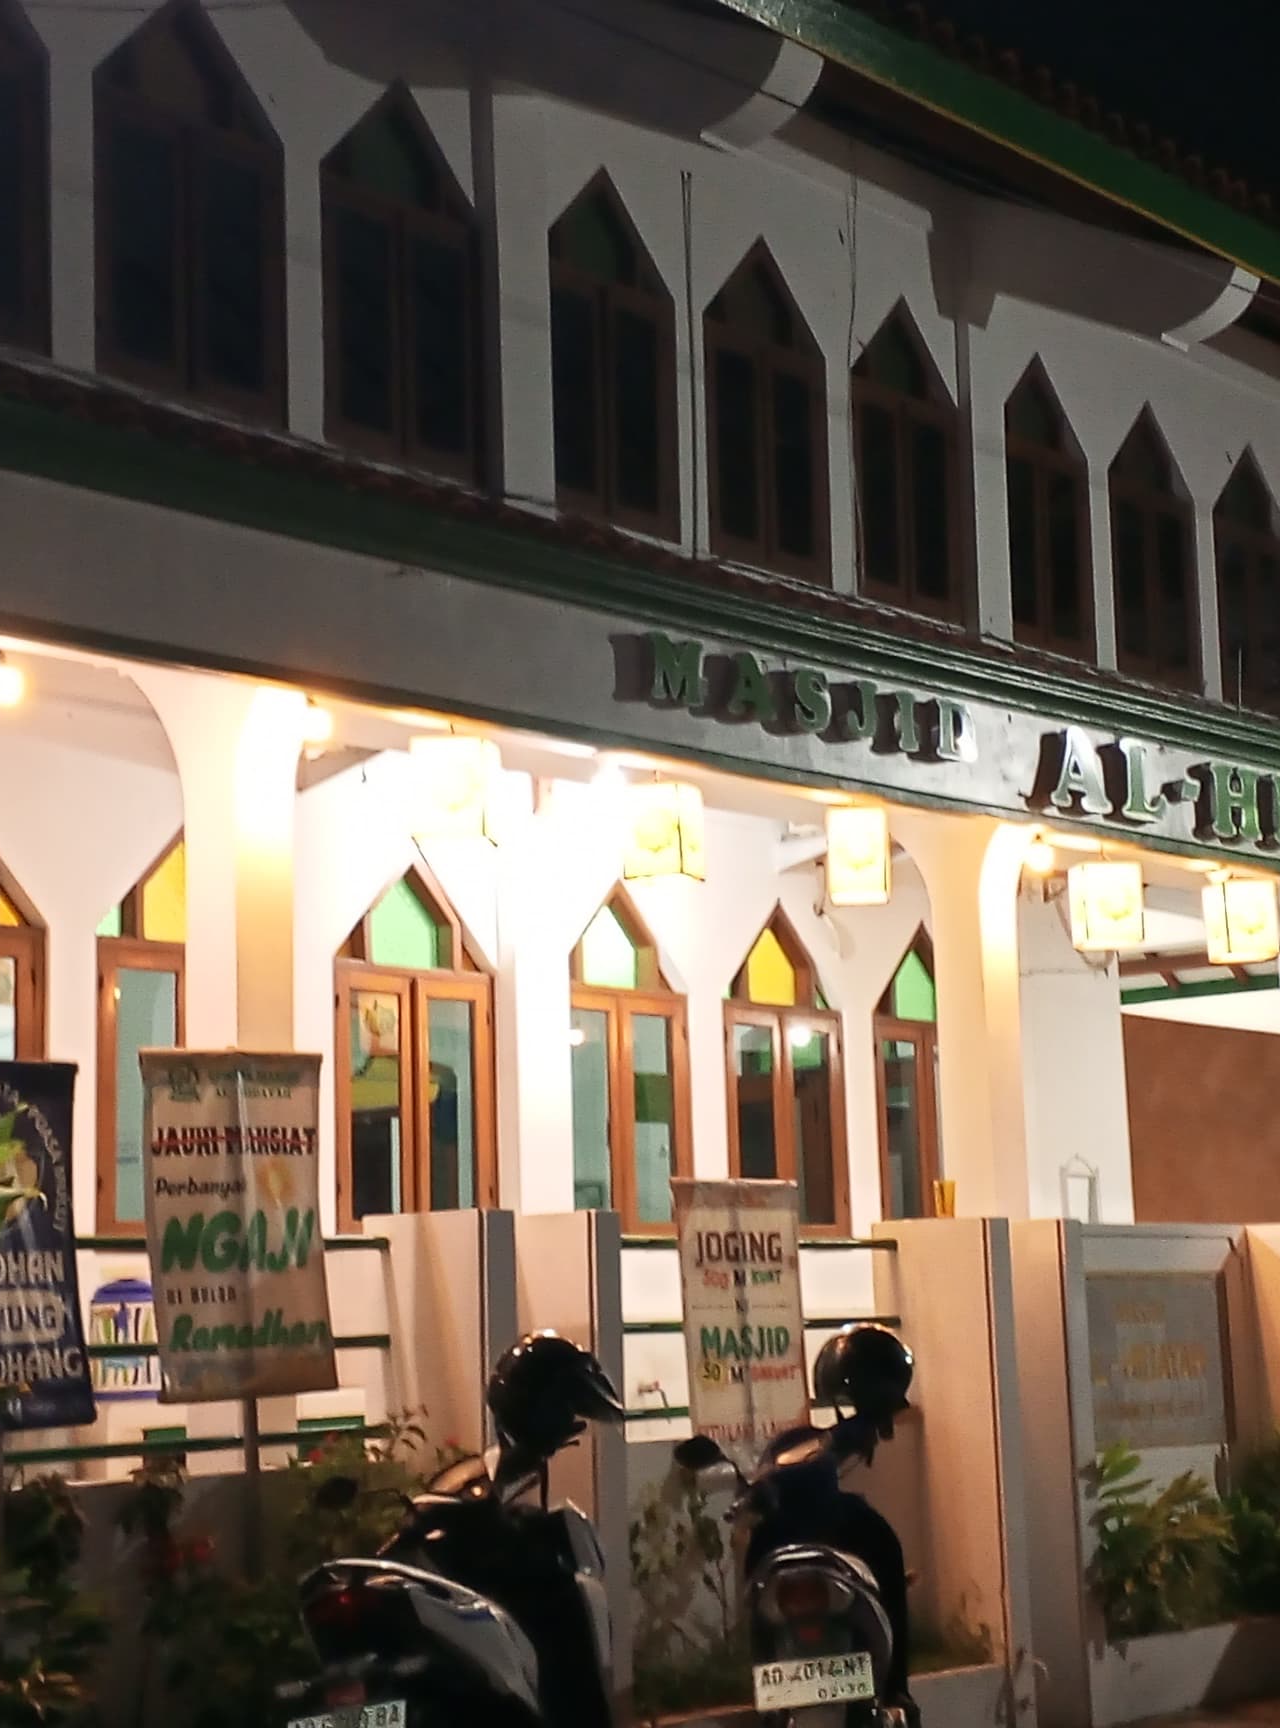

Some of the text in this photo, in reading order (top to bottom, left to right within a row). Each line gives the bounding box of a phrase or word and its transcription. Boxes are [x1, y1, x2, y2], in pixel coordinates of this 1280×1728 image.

[155, 1174, 246, 1200] Perbanya
[161, 1206, 315, 1274] NGAJI
[695, 1230, 783, 1269] JOGING
[700, 1324, 790, 1362] MASJID
[761, 1665, 784, 1687] AD
